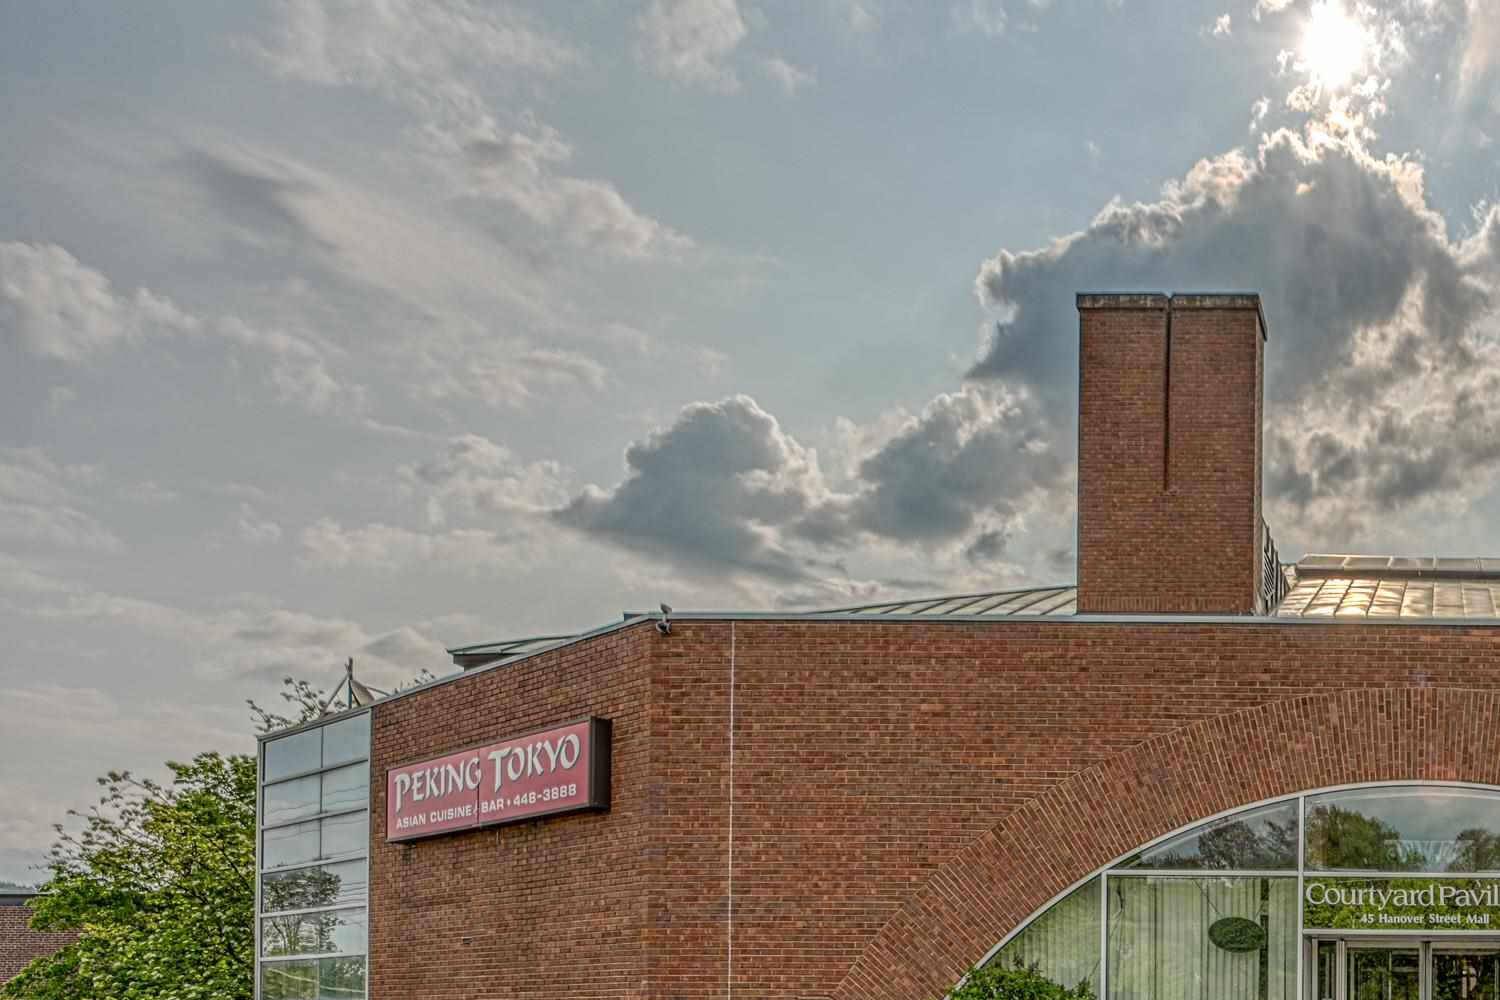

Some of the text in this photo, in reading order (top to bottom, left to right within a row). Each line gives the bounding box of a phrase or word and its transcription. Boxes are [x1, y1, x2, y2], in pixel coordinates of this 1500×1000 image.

[394, 733, 580, 812] PEKING TOKYO
[396, 812, 426, 830] ASIAN
[481, 798, 504, 813] BAR
[513, 783, 577, 806] 448-3888
[1305, 883, 1435, 910] Courtyard
[1360, 913, 1490, 924] 45 Hanover Street Mall
